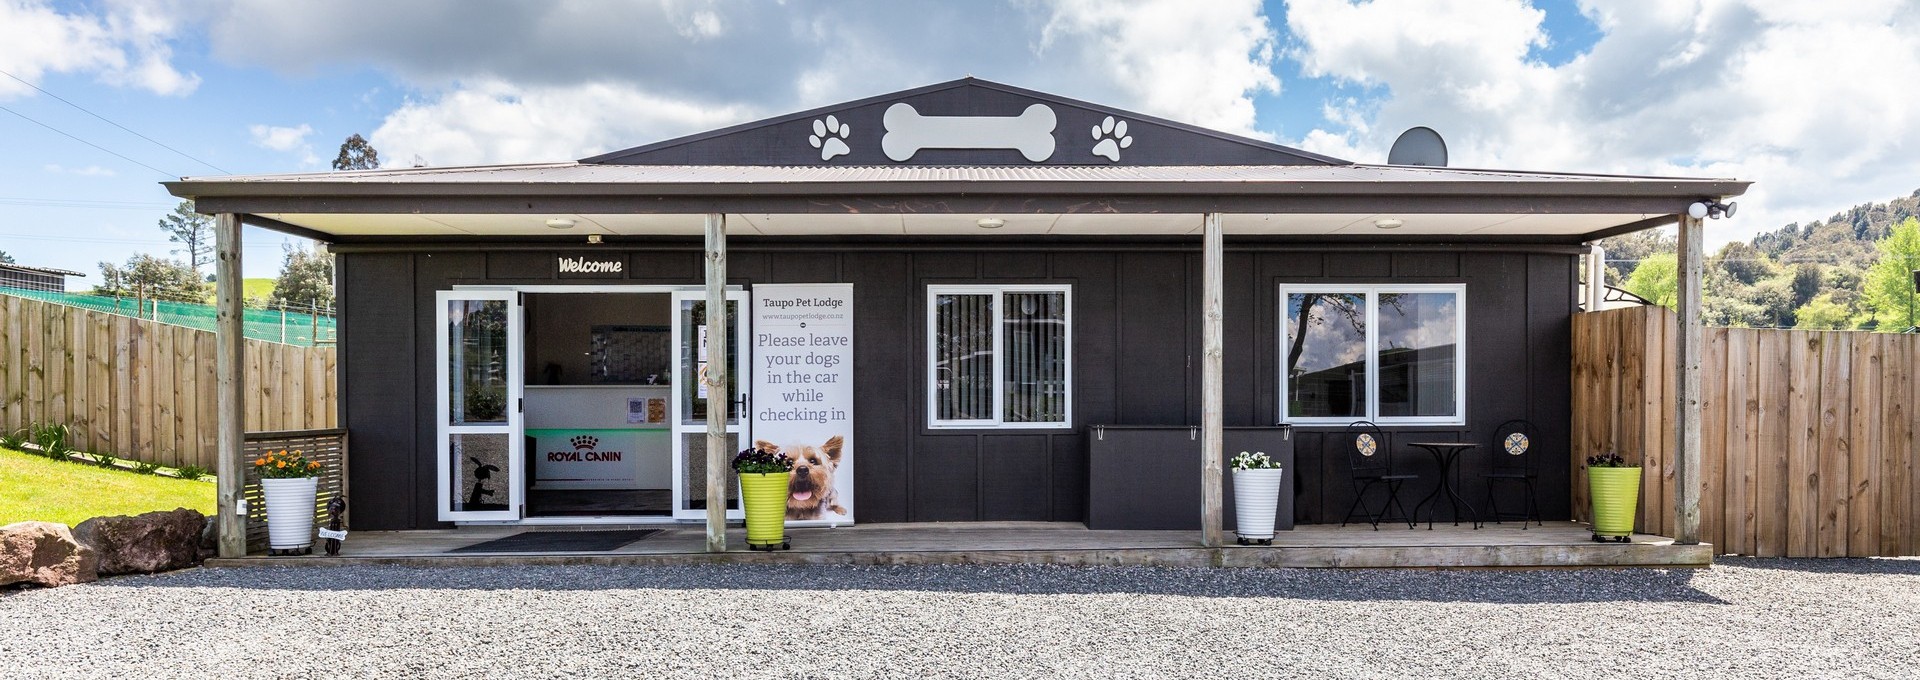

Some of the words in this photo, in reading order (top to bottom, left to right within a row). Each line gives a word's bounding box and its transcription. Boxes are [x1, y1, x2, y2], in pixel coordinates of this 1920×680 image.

[558, 256, 623, 273] Welcome
[763, 298, 794, 309] Taupo
[796, 298, 812, 307] Pet
[814, 297, 843, 309] Lodge
[758, 333, 806, 347] Please
[809, 333, 848, 347] leave
[765, 354, 802, 369] your
[805, 352, 840, 368] dogs
[767, 371, 782, 384] in
[786, 370, 811, 384] the
[815, 373, 839, 384] car
[782, 389, 824, 402] while
[759, 408, 828, 424] checking
[831, 407, 846, 421] in
[547, 451, 583, 462] ROYAL
[585, 451, 622, 462] CANIN
